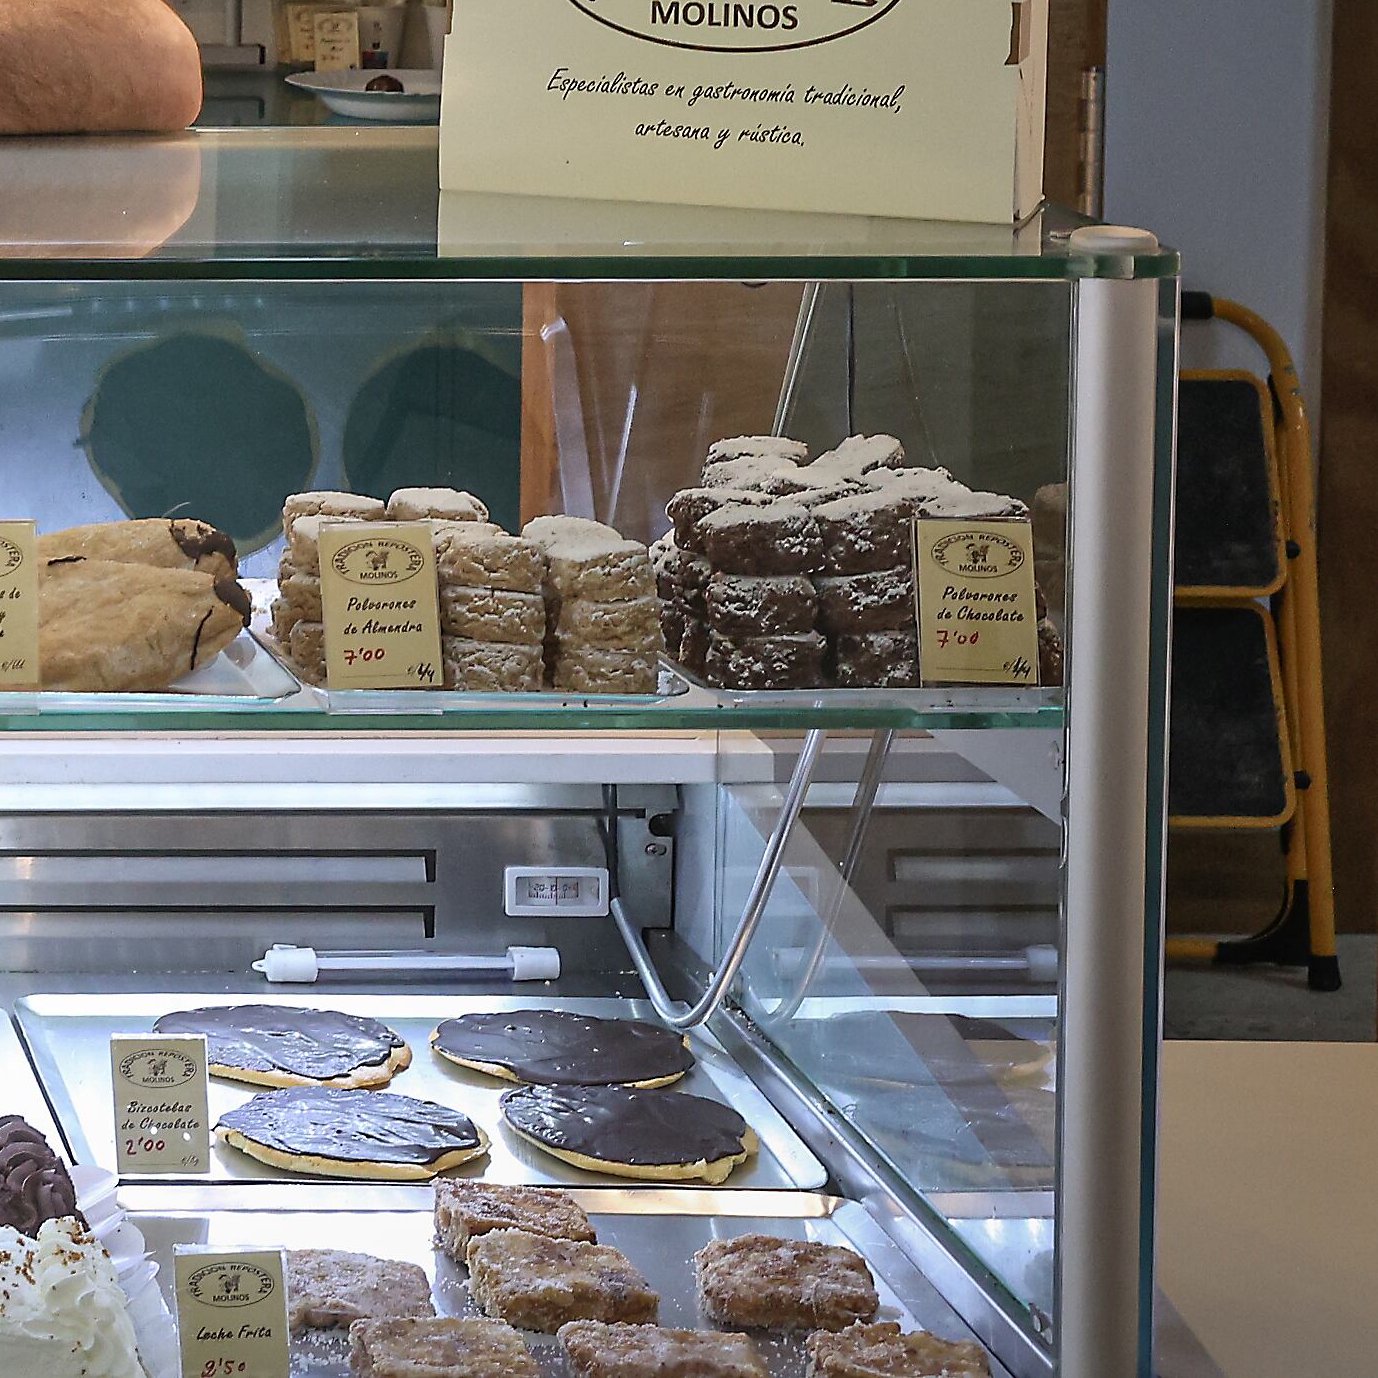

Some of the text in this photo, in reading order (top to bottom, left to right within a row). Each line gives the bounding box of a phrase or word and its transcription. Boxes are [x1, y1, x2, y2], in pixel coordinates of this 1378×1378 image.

[650, 0, 799, 31] MOLINOS
[546, 67, 904, 114] Especialistas en gastronomía tradicional,
[634, 119, 806, 149] artesana y rústica.
[959, 564, 998, 572] MOLINOS
[8, 587, 21, 599] de
[942, 585, 1018, 603] Polvorones
[347, 597, 416, 612] Polvorones
[0, 611, 6, 624] y
[937, 606, 1024, 622] de Chocolate
[344, 619, 422, 635] de Almendra
[128, 1101, 192, 1113] Bizcotelas
[122, 1119, 134, 1130] de
[126, 1136, 165, 1155] 2'00
[213, 1294, 249, 1302] MOLINOS
[197, 1325, 271, 1340] Leche Frita
